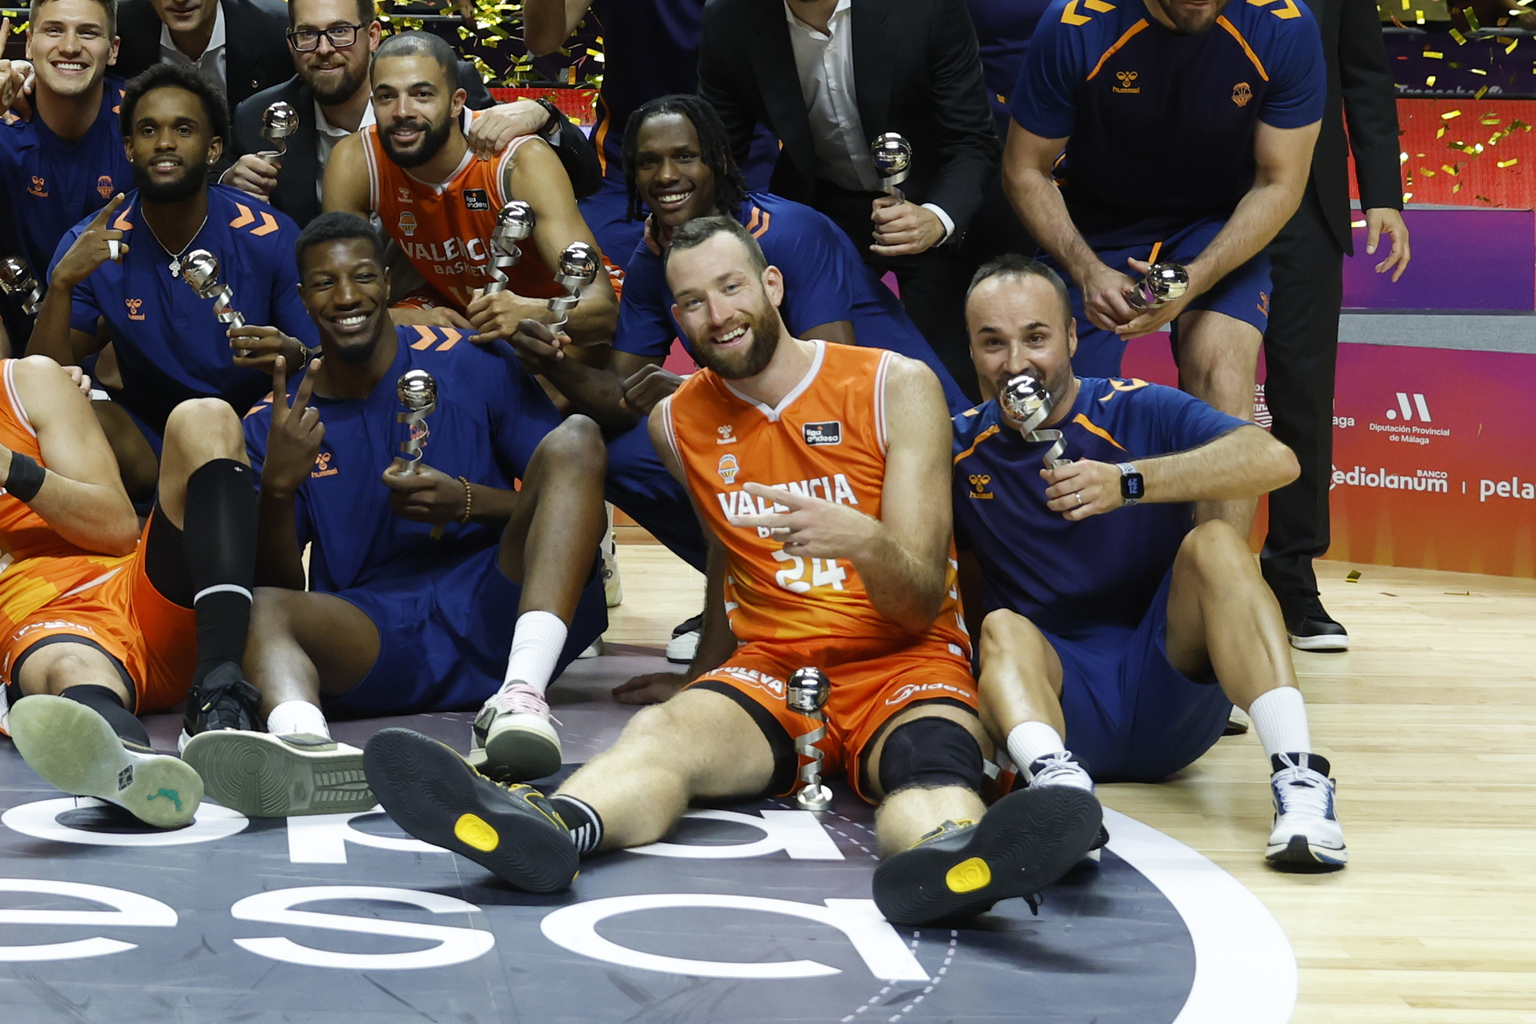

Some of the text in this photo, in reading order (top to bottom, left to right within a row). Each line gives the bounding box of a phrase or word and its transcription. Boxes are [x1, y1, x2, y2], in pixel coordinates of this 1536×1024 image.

[434, 261, 487, 277] BASKET
[1369, 423, 1451, 437] Diputación Provincial
[1389, 434, 1430, 445] de Málaga
[1331, 466, 1448, 493] ediolanum
[1417, 469, 1448, 479] BANCO
[717, 474, 859, 523] VALENCIA
[1480, 476, 1536, 502] pela
[771, 549, 847, 594] 24
[710, 666, 783, 694] PULEVA
